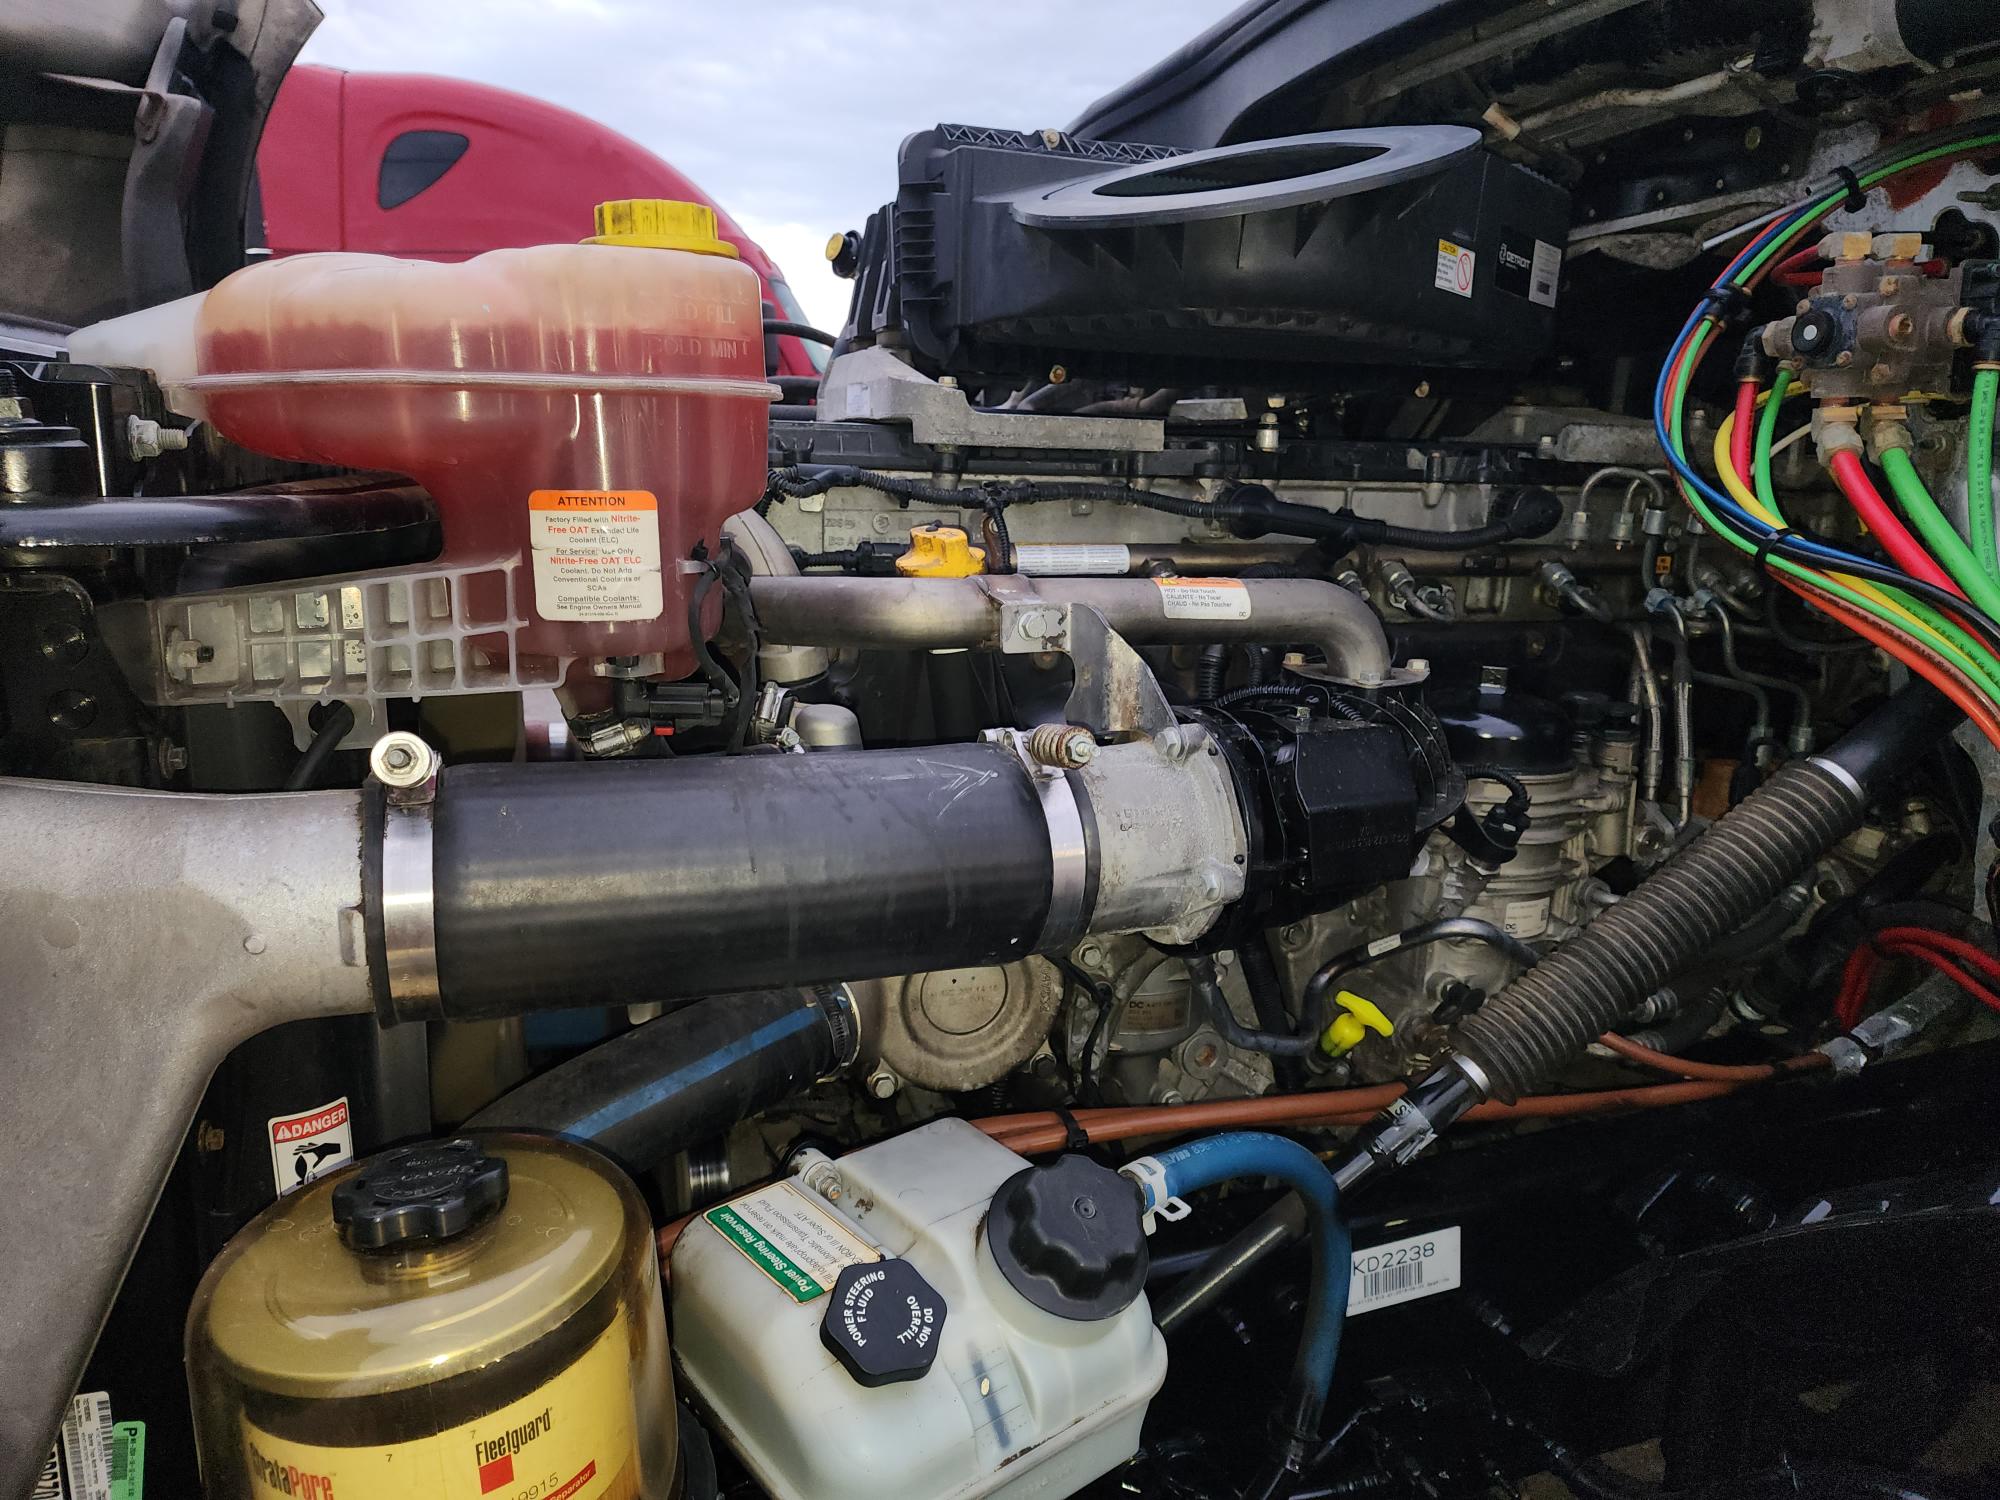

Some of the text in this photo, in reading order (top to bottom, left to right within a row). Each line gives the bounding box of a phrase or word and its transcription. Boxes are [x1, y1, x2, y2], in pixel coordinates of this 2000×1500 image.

[710, 340, 738, 359] MIN
[557, 496, 626, 506] ATTENTION
[545, 516, 570, 524] Factory
[611, 515, 641, 523] Nitrite-
[548, 526, 567, 534] Free
[569, 526, 589, 534] OAT
[598, 537, 619, 545] (ELC)
[617, 548, 634, 556] Only
[550, 556, 642, 565] Nitrite-Free OAT ELC
[557, 595, 640, 603] Compatible Coolants:
[1129, 1001, 1145, 1009] DC
[291, 1107, 346, 1138] DANGER
[758, 1199, 840, 1265] Automatic Transmission Fluid
[763, 1220, 773, 1231] on
[808, 1219, 827, 1236] Super
[772, 1229, 786, 1242] mark
[824, 1232, 834, 1241] or
[719, 1212, 813, 1293] Power Steering Reservoir
[785, 1240, 821, 1272] appropriate
[837, 1244, 864, 1265] EXRON
[1352, 1241, 1436, 1276] KD2238
[823, 1273, 834, 1285] Fill
[843, 1270, 886, 1348] POWER STEERING
[856, 1288, 874, 1324] FLUID
[896, 1294, 922, 1345] OVERFILL
[915, 1307, 934, 1348] DO NOT
[123, 1427, 138, 1437] P
[469, 1429, 477, 1440] 7
[475, 1409, 552, 1467] Fleetguard
[385, 1453, 393, 1463] 7
[249, 1442, 335, 1500] rataPore
[512, 1471, 559, 1500] 9915
